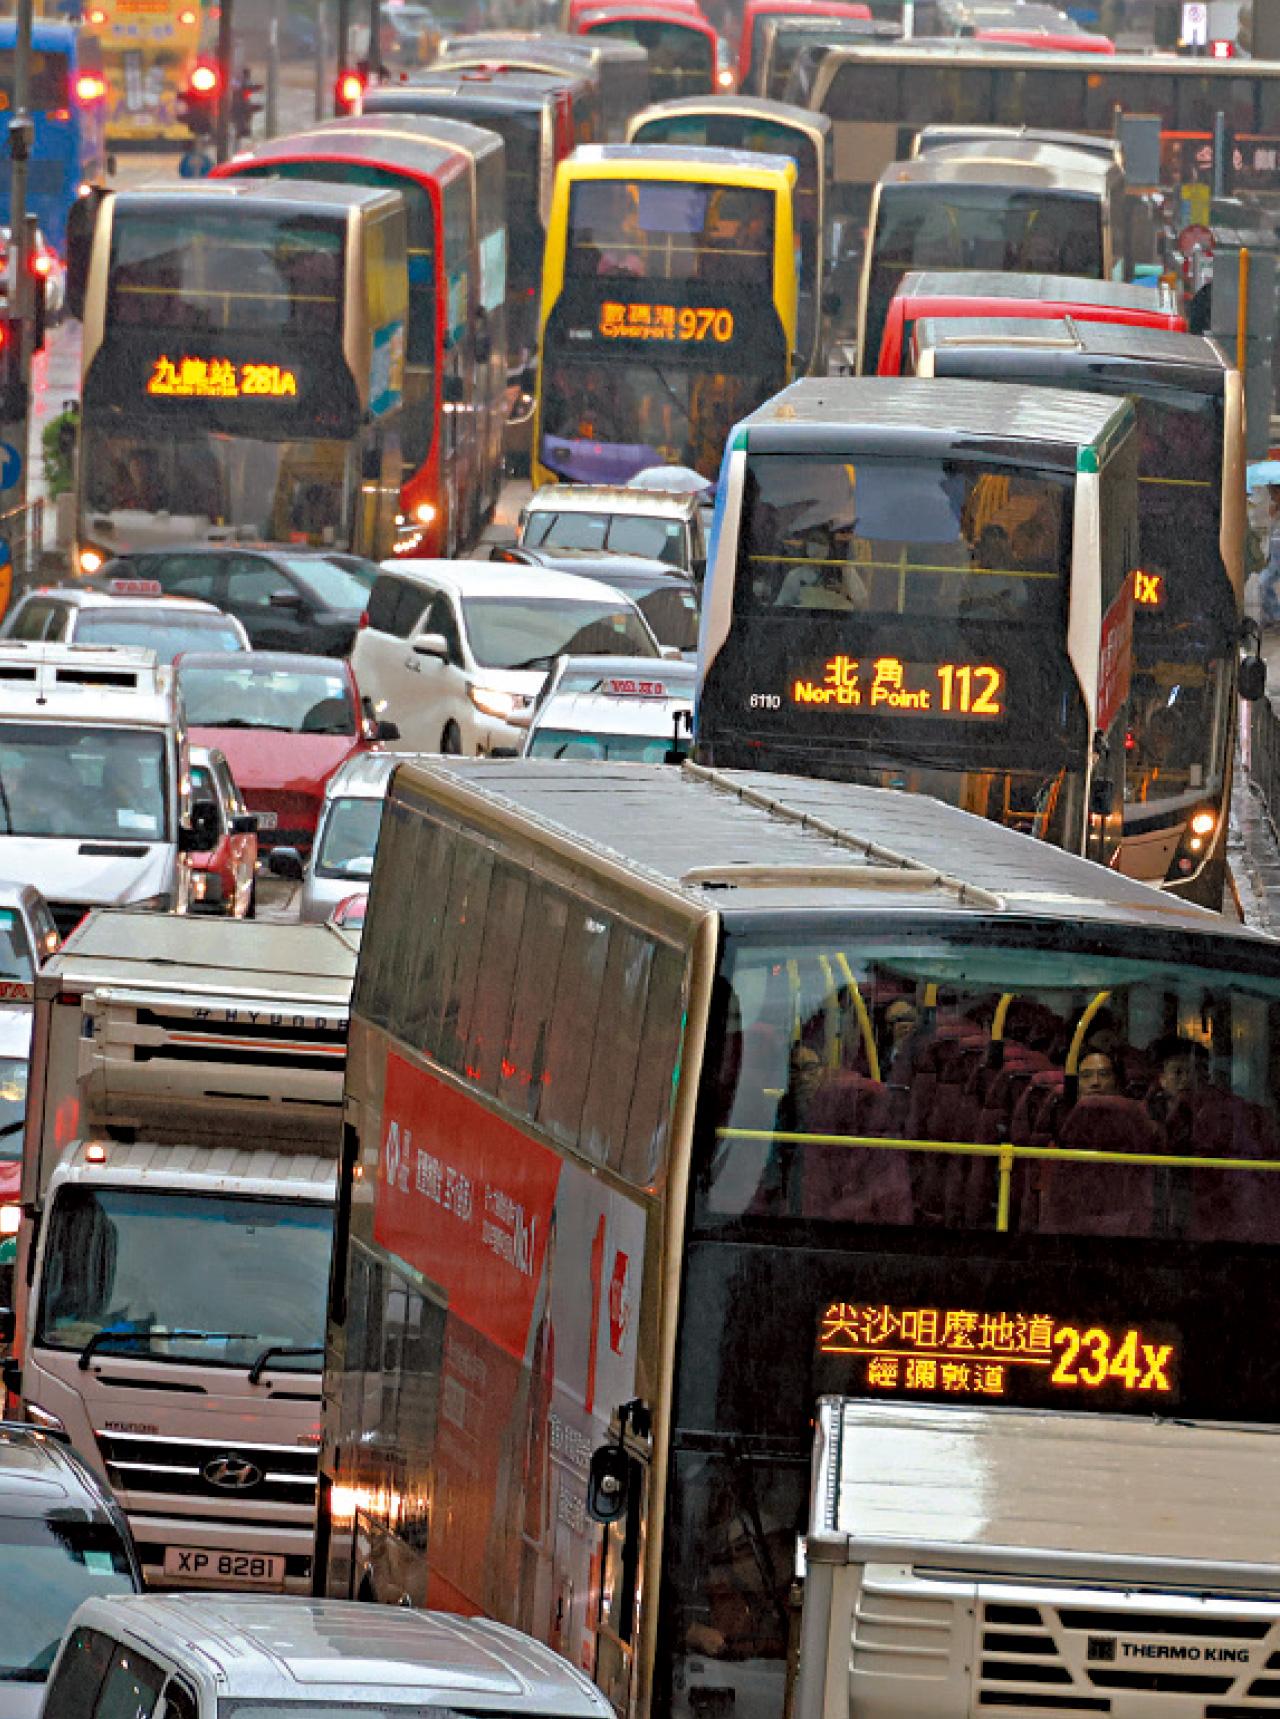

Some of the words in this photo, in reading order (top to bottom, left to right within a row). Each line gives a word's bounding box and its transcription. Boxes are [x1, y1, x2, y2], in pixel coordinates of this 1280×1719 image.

[678, 307, 734, 342] 970
[824, 655, 904, 688] 北角
[793, 680, 861, 705] North
[869, 686, 931, 710] Point
[936, 664, 1001, 714] 112
[867, 1355, 1005, 1395] 經彌敦道
[178, 1552, 208, 1572] XP
[218, 1554, 274, 1578] 8281
[1121, 1642, 1200, 1661] THERMO
[1204, 1648, 1249, 1663] KING
